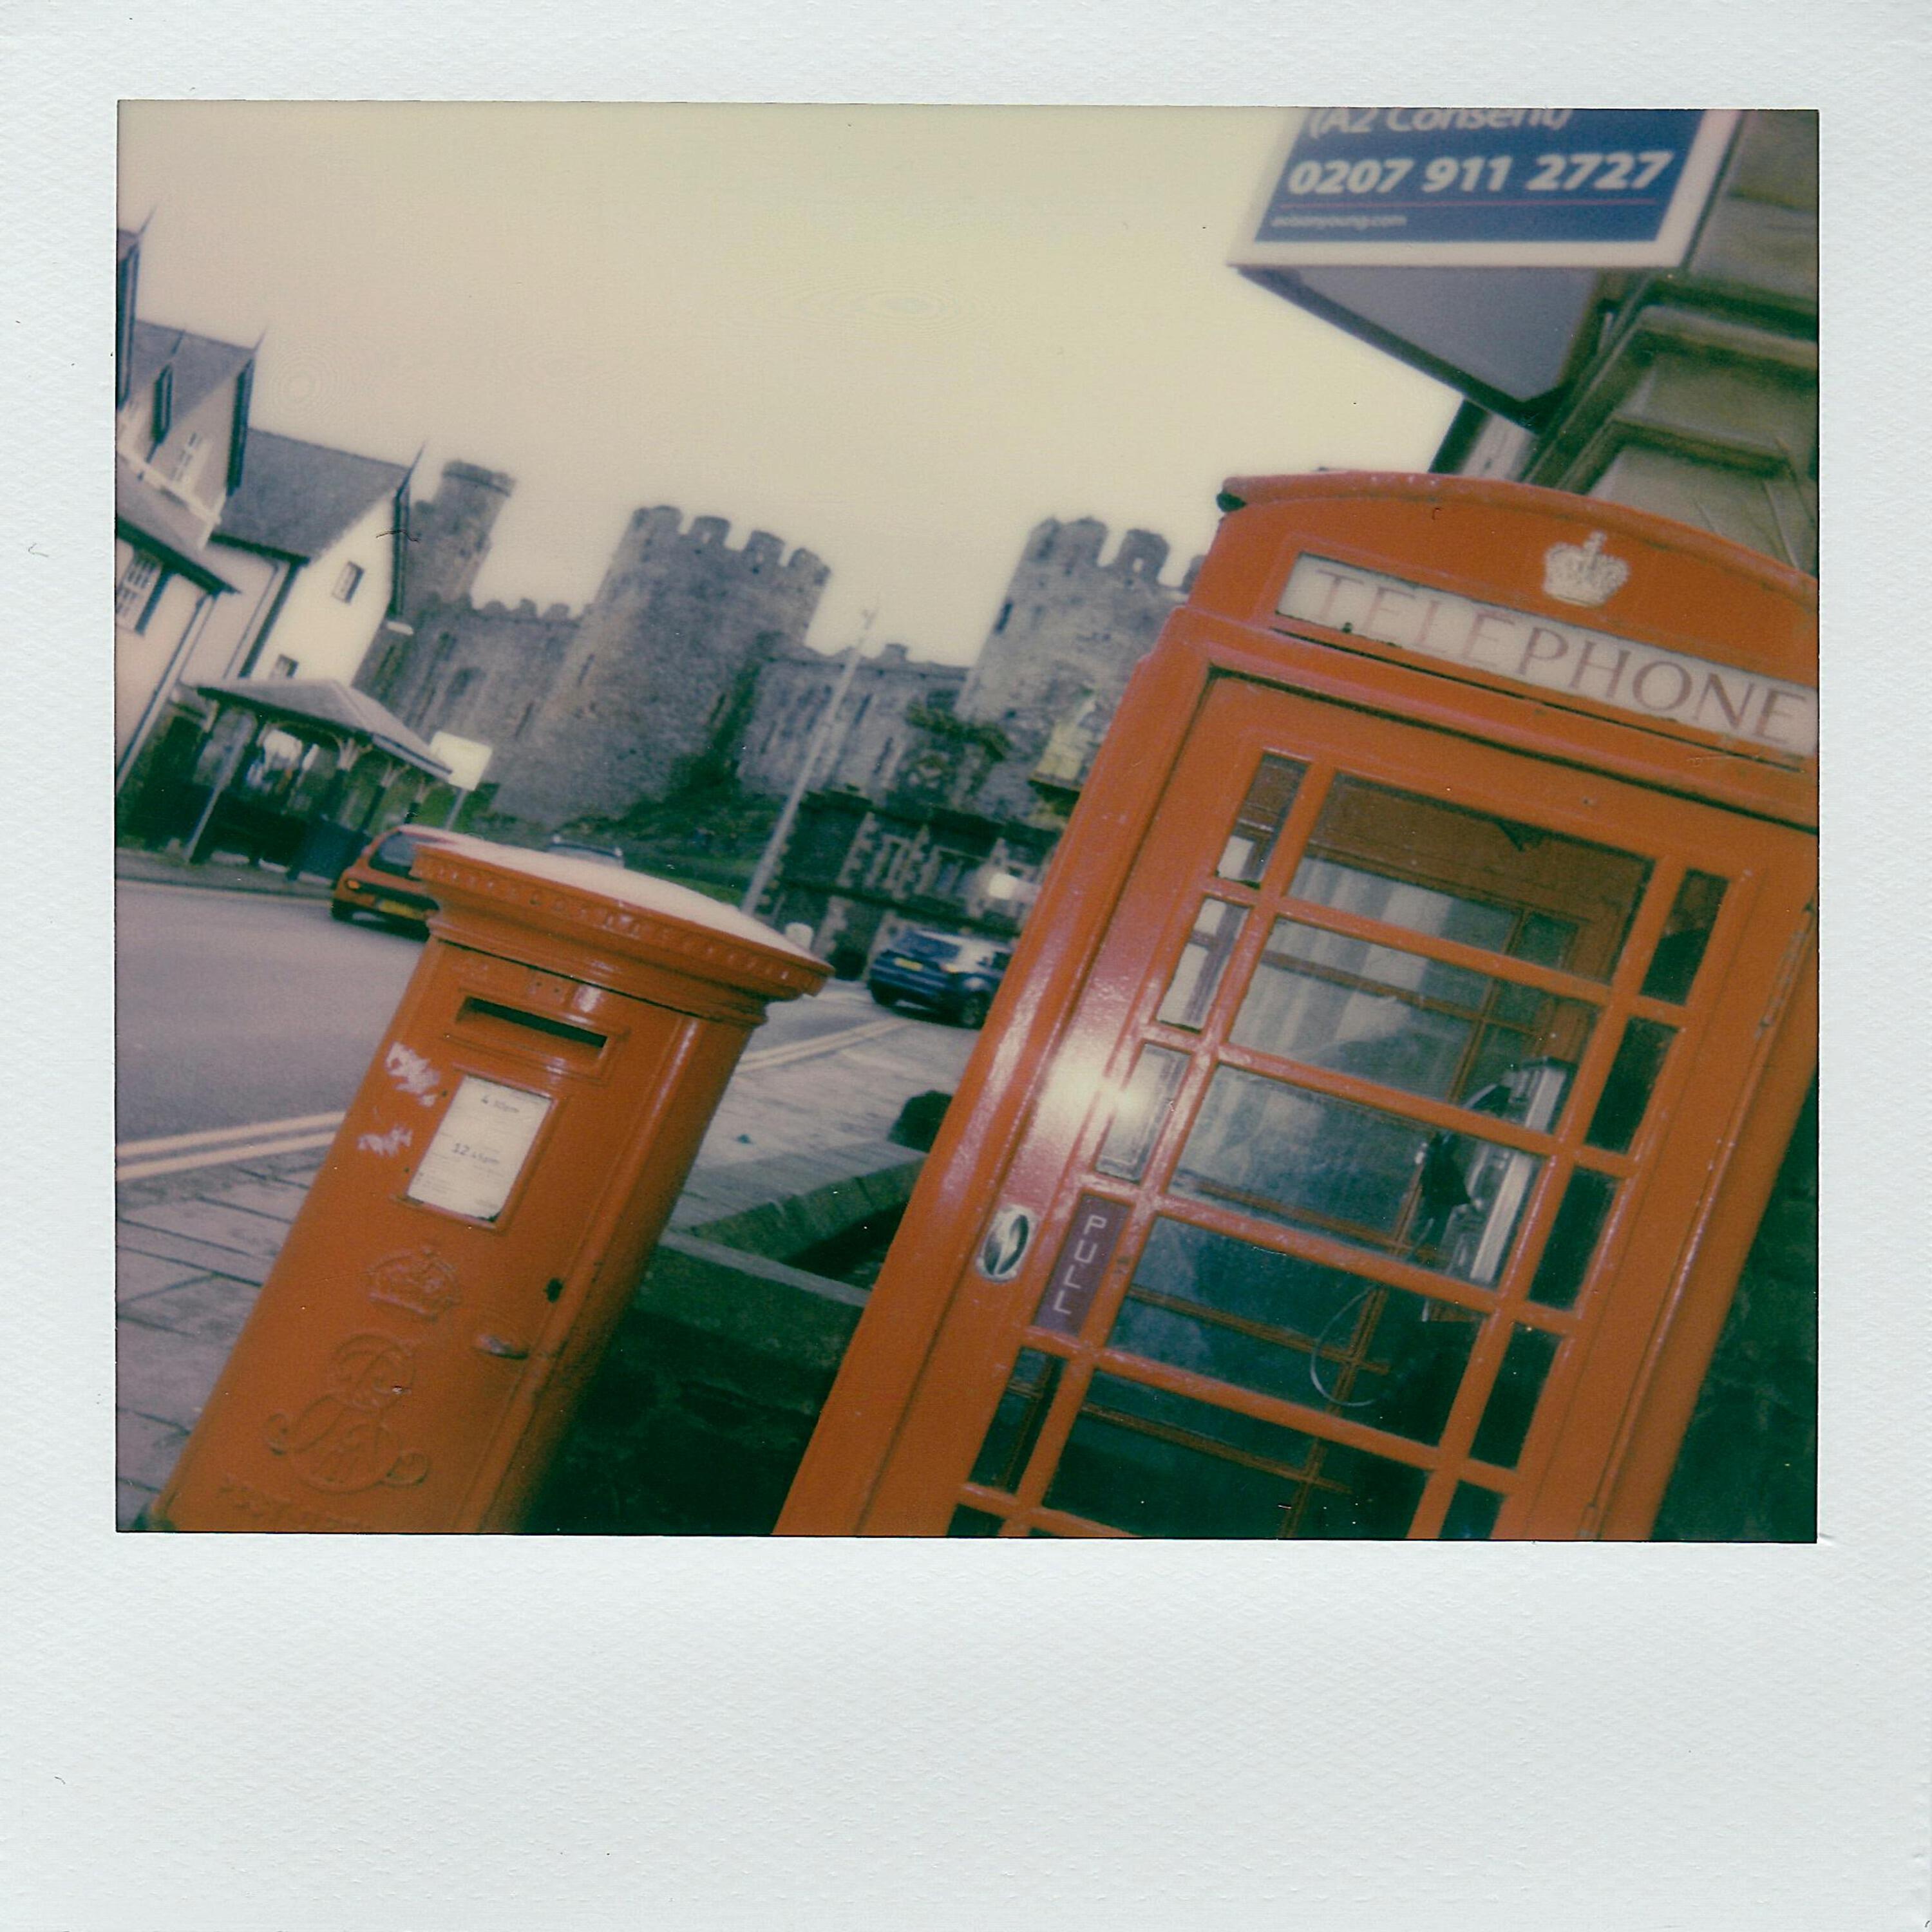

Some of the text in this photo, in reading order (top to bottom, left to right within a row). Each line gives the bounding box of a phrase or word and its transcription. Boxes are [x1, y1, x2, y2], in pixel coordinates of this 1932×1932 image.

[1289, 151, 1672, 194] 0207 911 2727
[1316, 568, 1807, 745] TELEPHONE
[1053, 1214, 1108, 1315] PULL
